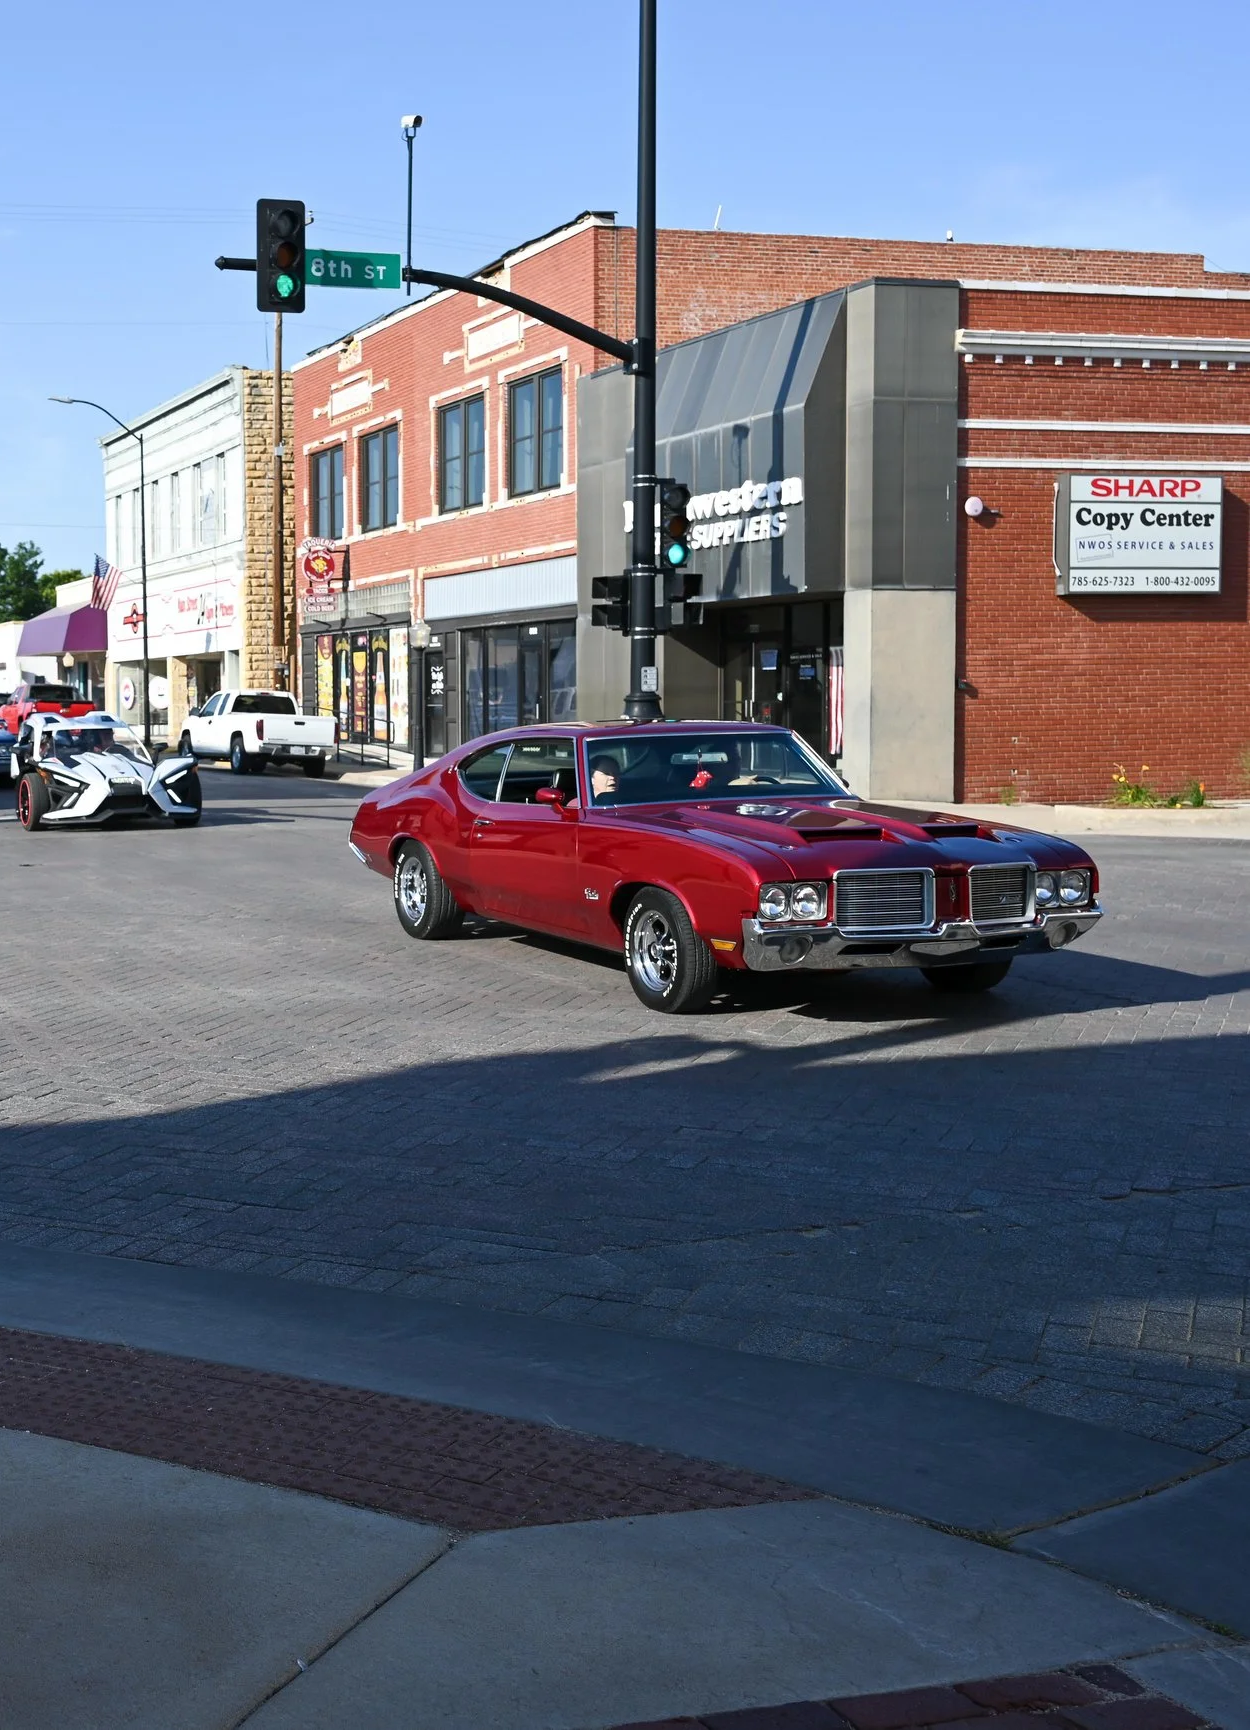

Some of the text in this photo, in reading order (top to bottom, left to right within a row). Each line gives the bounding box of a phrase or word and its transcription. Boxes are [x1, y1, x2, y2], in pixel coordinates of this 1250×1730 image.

[311, 258, 387, 280] 8th ST
[1090, 478, 1201, 498] SHARP
[1075, 507, 1215, 531] Copy Center
[691, 511, 788, 550] SUPPLIERS
[303, 538, 336, 550] TAQUERIA
[1078, 540, 1214, 551] NWOS SERVICE & SALES
[1071, 576, 1216, 587] 785-625-7323 1-800-432-0095
